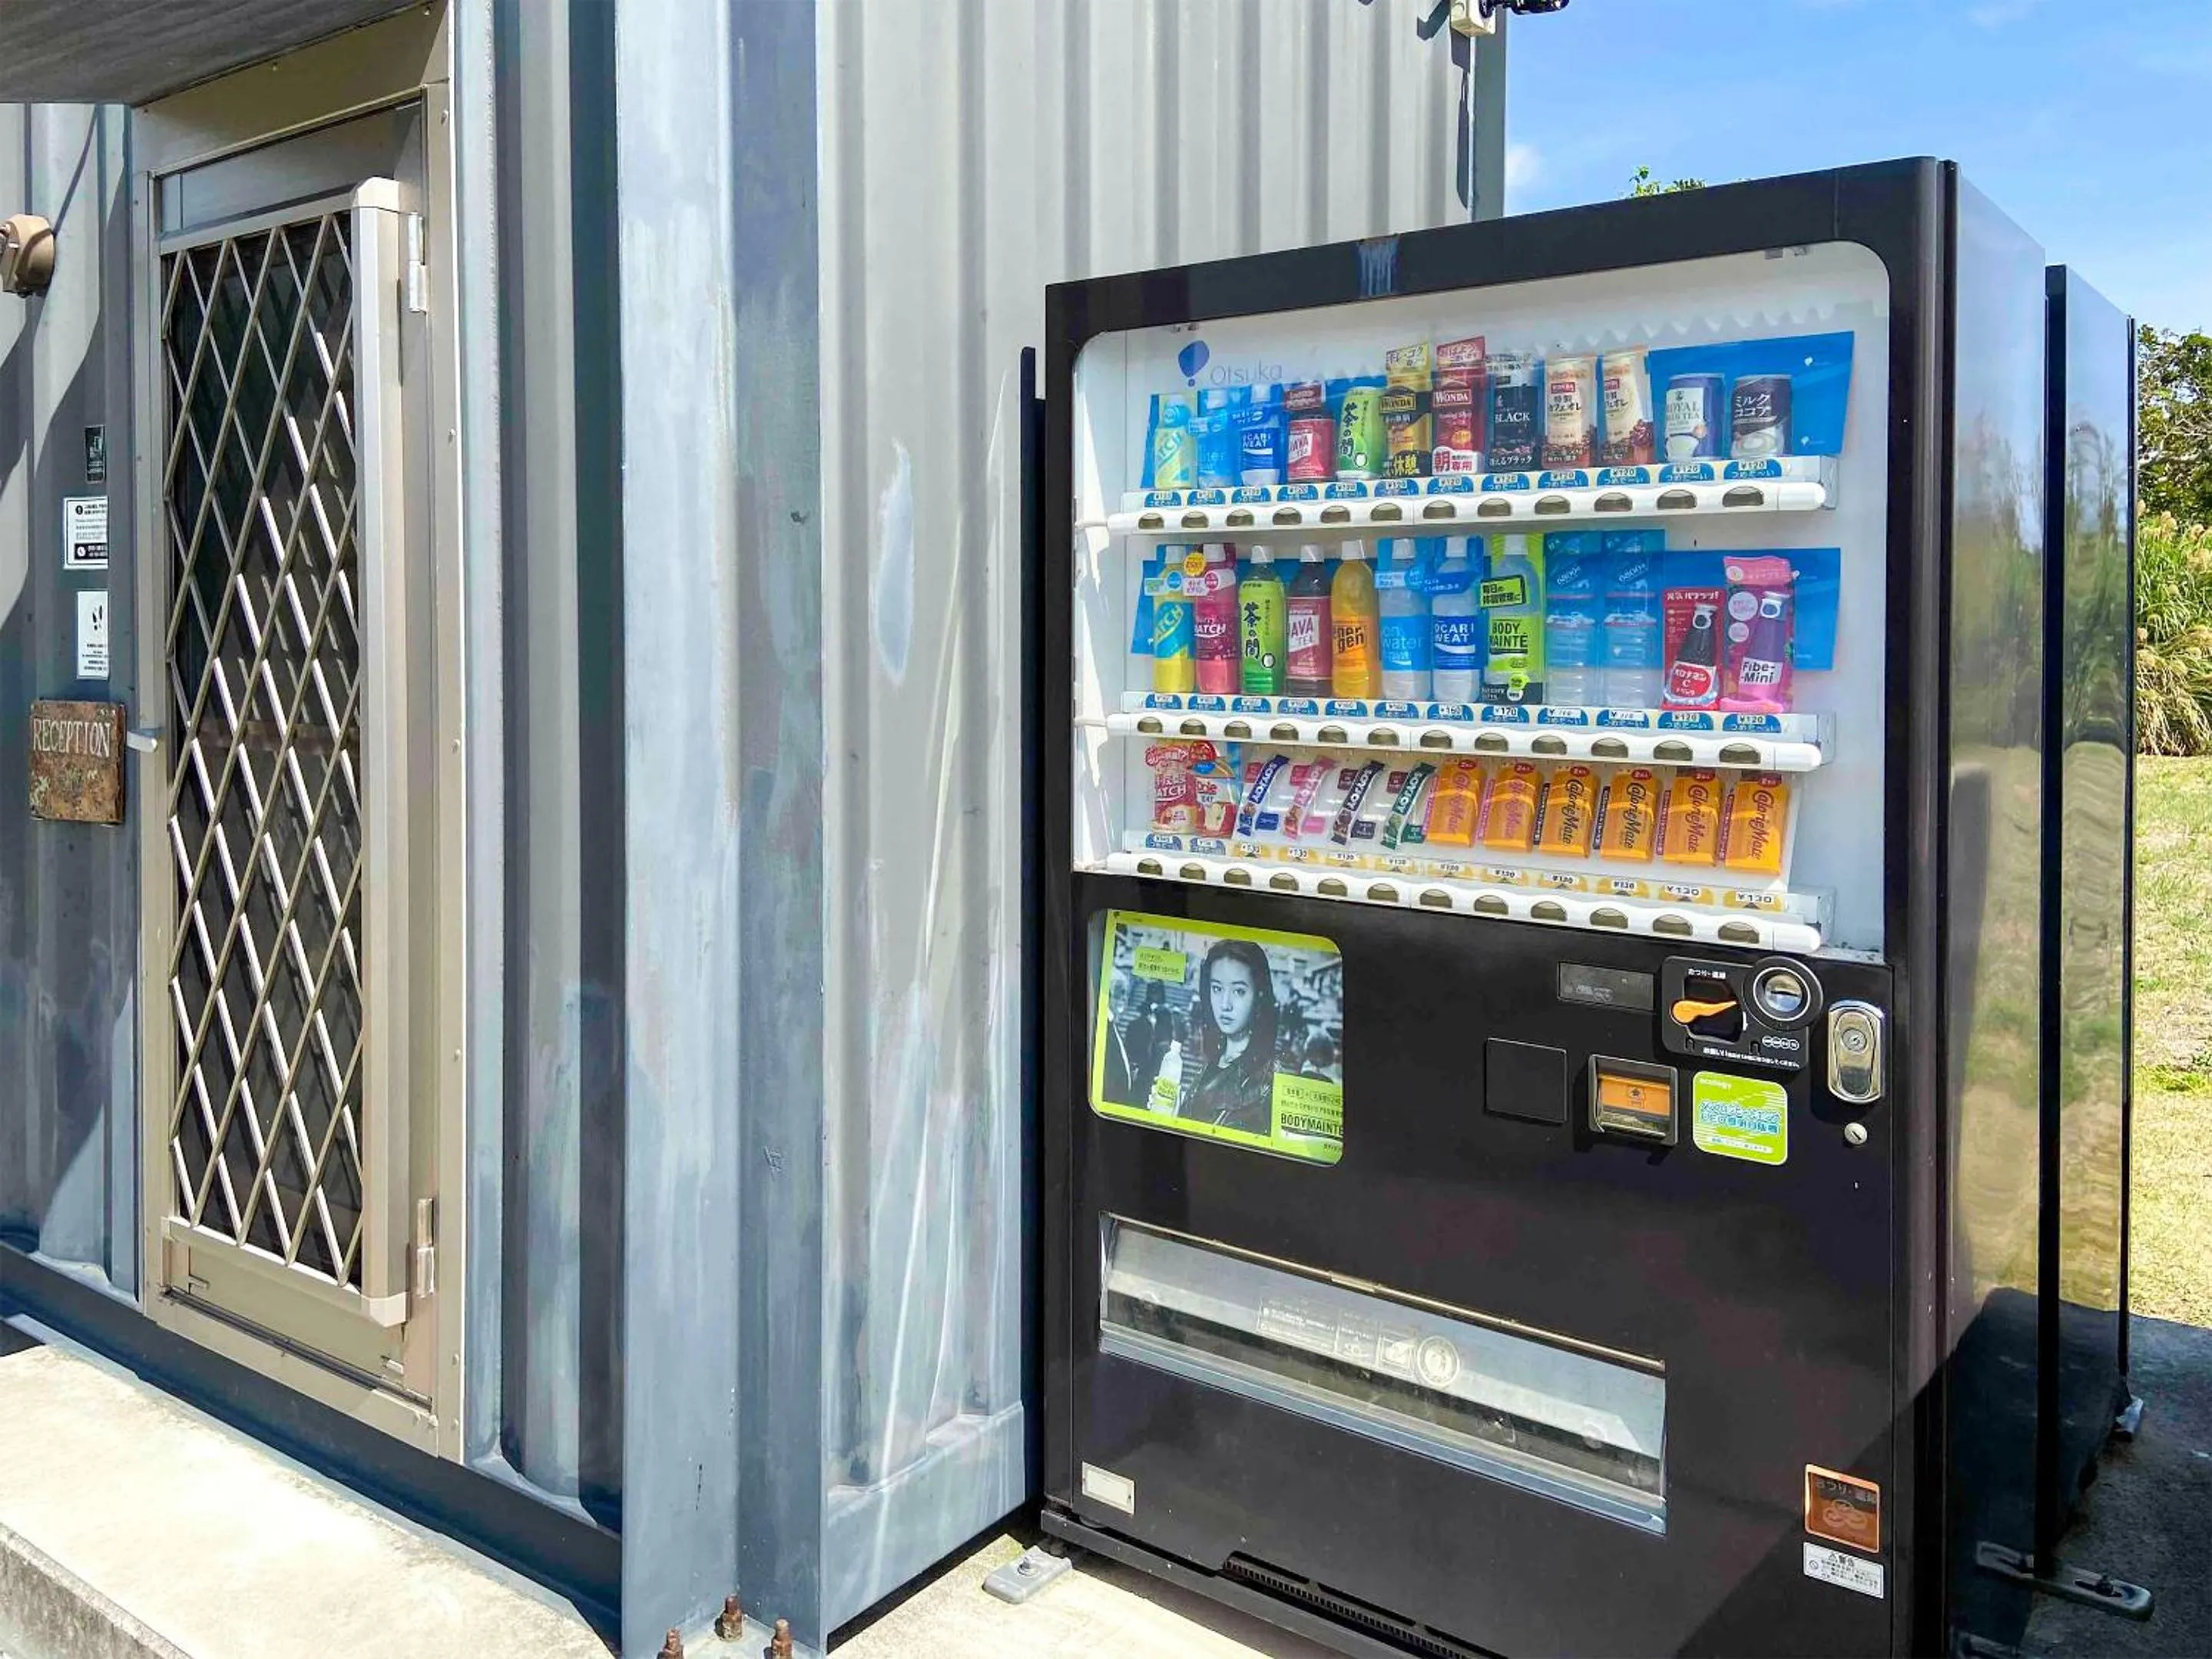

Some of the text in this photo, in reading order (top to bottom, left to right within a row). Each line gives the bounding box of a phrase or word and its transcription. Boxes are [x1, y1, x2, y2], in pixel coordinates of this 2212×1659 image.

[1210, 358, 1283, 386] Otsuka
[1435, 389, 1469, 404] WONDA
[1735, 393, 1770, 408] ミルク
[1669, 402, 1700, 412] OYAL
[1734, 406, 1772, 418] ココア
[1676, 465, 1698, 473] ¥120
[1741, 461, 1766, 469] ¥120
[1553, 472, 1574, 480] ¥120
[1612, 468, 1634, 476] ¥120
[1291, 616, 1313, 638] AVA
[1434, 623, 1474, 634] OCARI
[1492, 623, 1520, 634] BODY
[1339, 632, 1364, 654] gen
[1434, 633, 1469, 643] WEAT
[1494, 706, 1517, 716] ¥170
[33, 718, 111, 757] RECEPTION
[1157, 786, 1187, 797] ATCH
